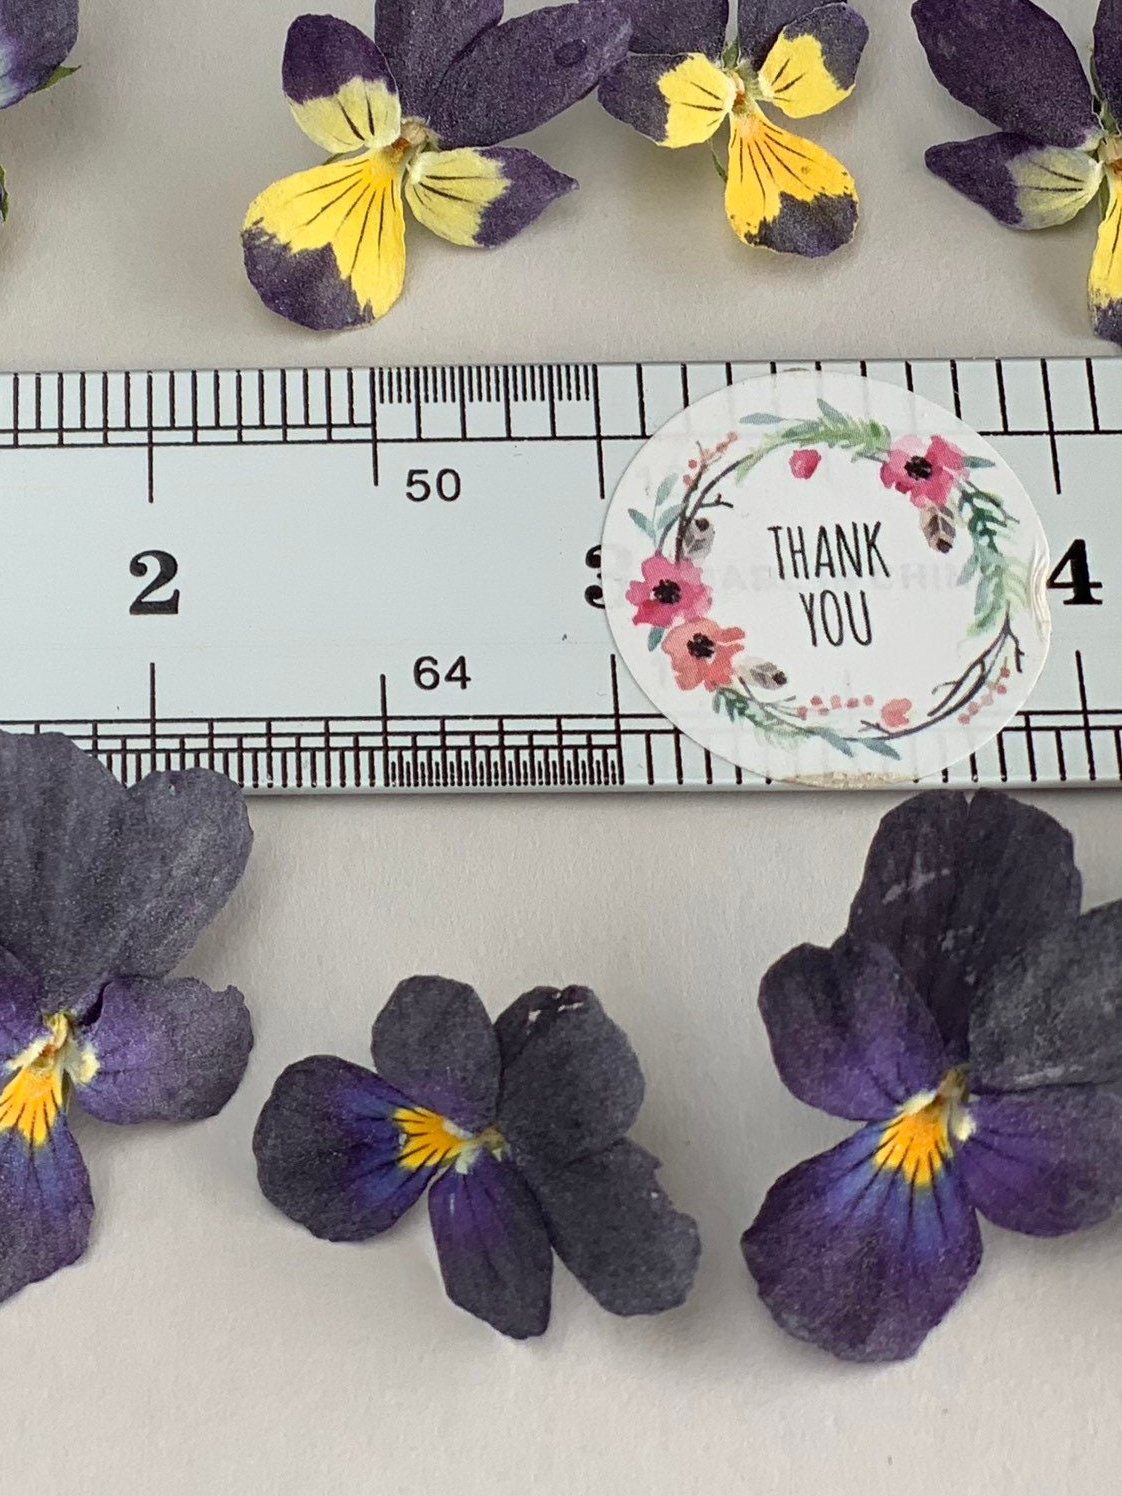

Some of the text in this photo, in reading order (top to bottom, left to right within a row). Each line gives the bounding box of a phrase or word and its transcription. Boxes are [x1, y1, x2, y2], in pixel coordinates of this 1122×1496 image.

[405, 468, 461, 503] 50
[767, 520, 890, 580] THANK
[1045, 538, 1103, 606] 4
[128, 549, 181, 616] 2
[798, 589, 873, 648] YOU
[413, 655, 472, 691] 64
